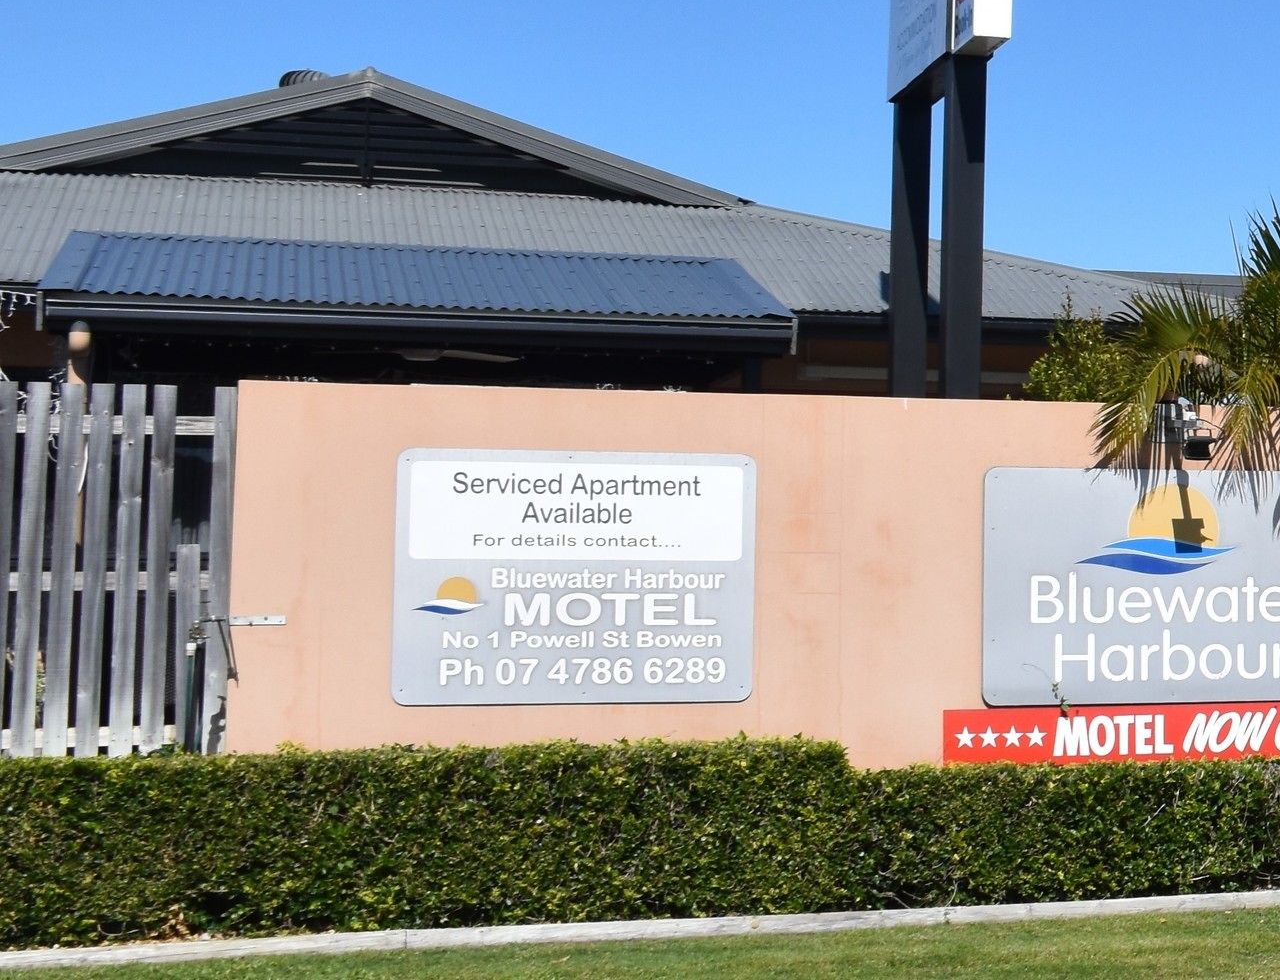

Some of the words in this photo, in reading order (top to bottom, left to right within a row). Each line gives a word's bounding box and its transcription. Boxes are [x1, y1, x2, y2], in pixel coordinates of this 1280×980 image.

[453, 472, 562, 495] Serviced
[571, 473, 702, 500] Apartment
[522, 502, 633, 525] Available
[473, 534, 505, 547] For
[511, 534, 577, 548] details
[491, 568, 617, 589] Bluewater
[624, 569, 725, 589] Harbour
[504, 592, 717, 627] MOTEL
[442, 631, 479, 649] No
[487, 631, 500, 648] 1
[510, 630, 595, 648] Powell
[602, 631, 630, 648] St
[637, 631, 722, 648] Bowen
[439, 658, 484, 686] Ph
[495, 658, 539, 685] 07
[547, 658, 634, 685] 4786
[643, 657, 726, 684] 6289
[1053, 714, 1173, 757] MOTEL
[1183, 707, 1278, 753] NOW
